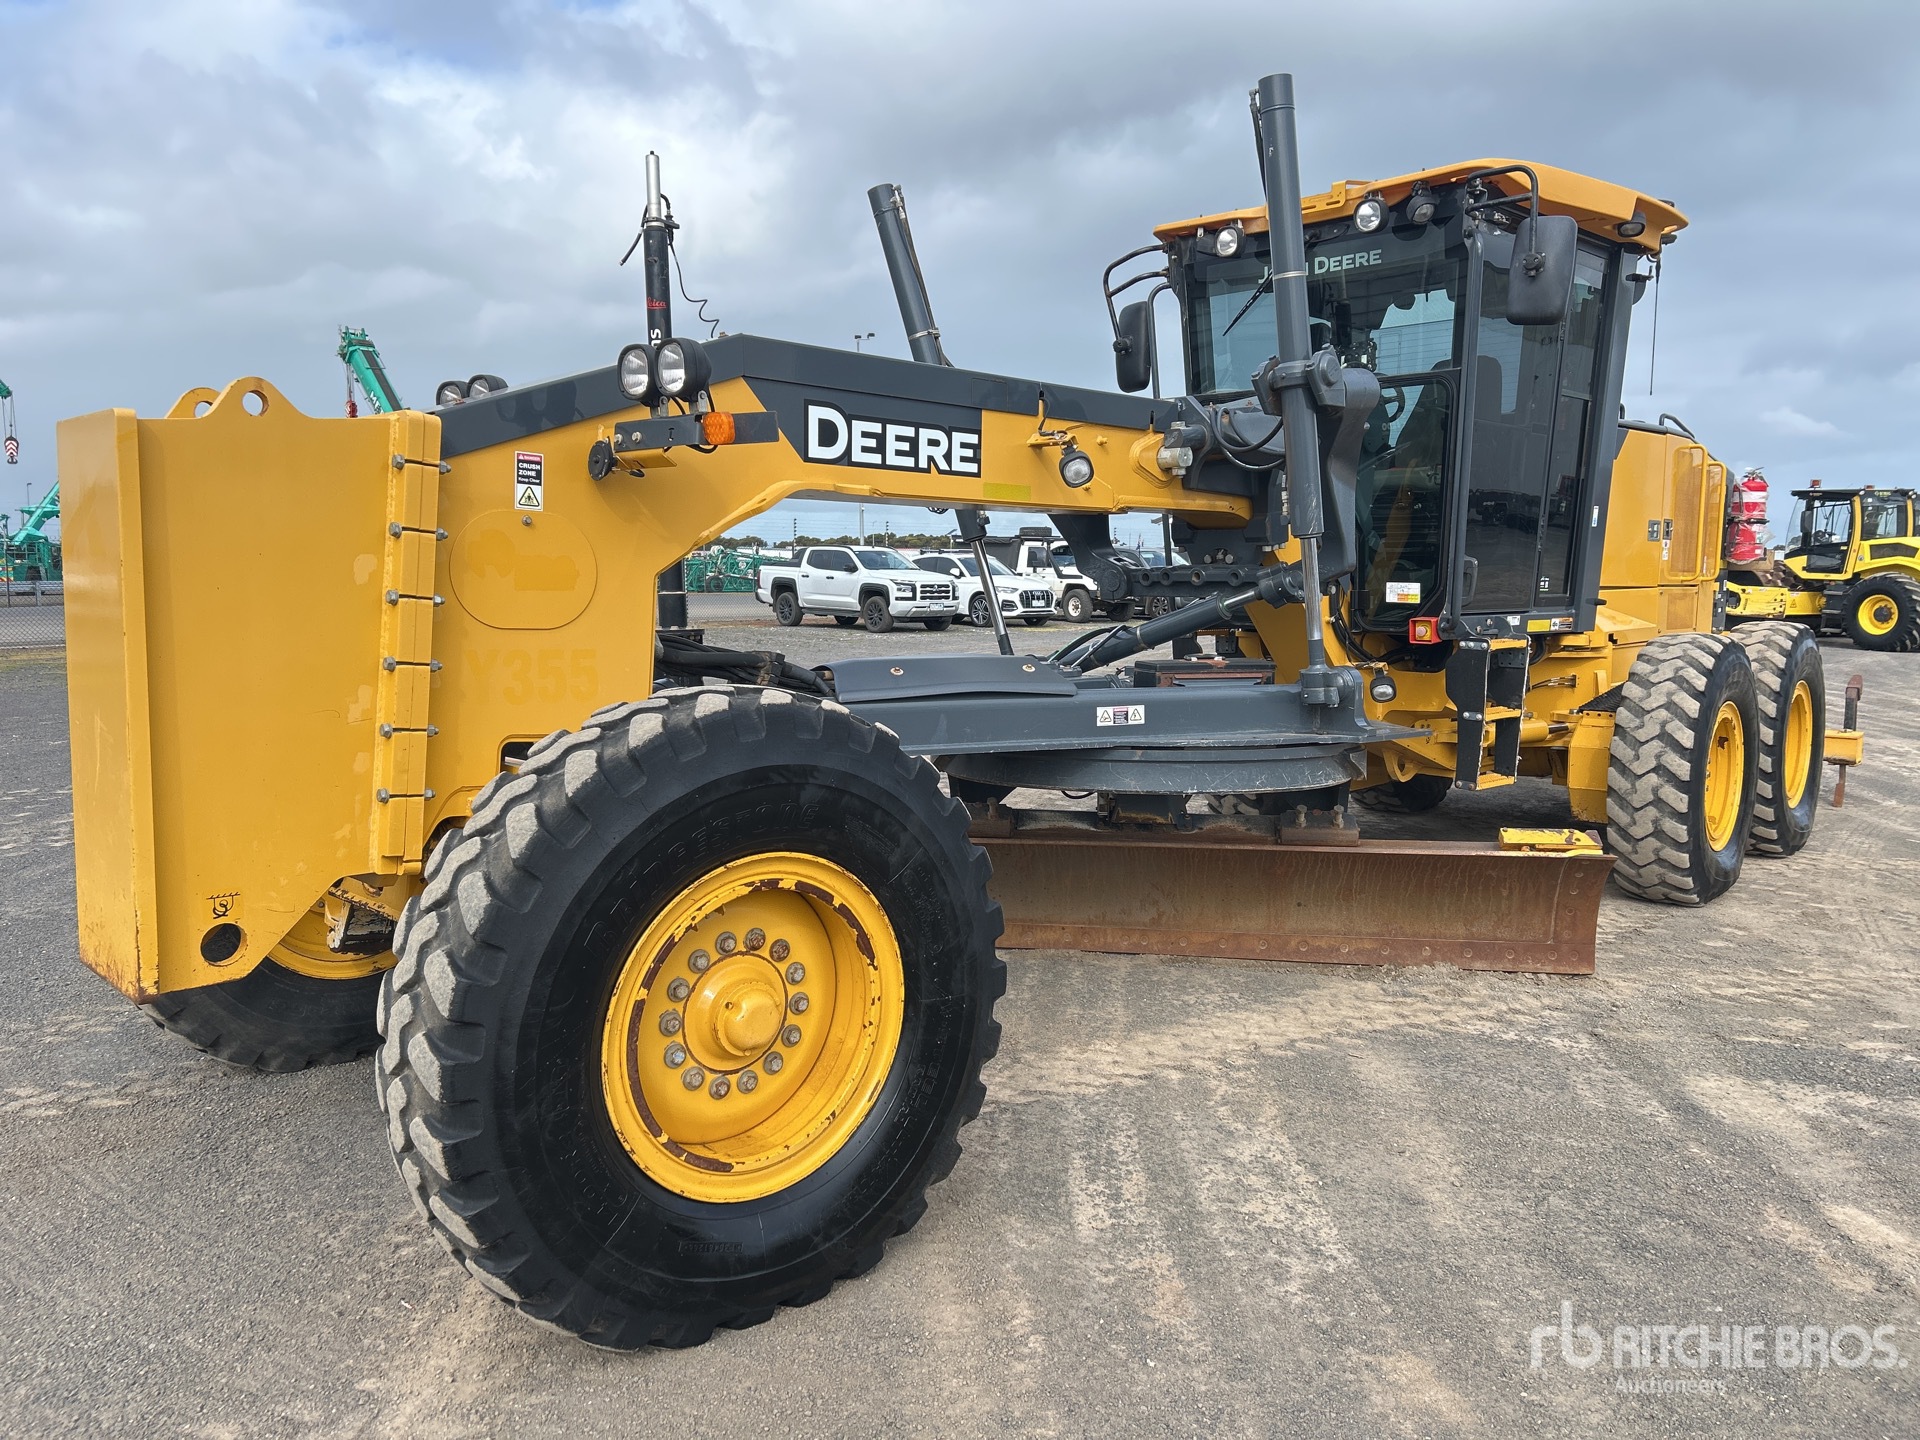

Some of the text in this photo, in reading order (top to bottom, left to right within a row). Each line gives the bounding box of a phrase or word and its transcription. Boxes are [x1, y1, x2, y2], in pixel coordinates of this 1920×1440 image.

[1314, 249, 1382, 275] DEERE
[807, 404, 979, 474] DEERE
[518, 462, 541, 470] CRUSH
[518, 469, 537, 477] ZONE
[465, 649, 599, 706] Y355
